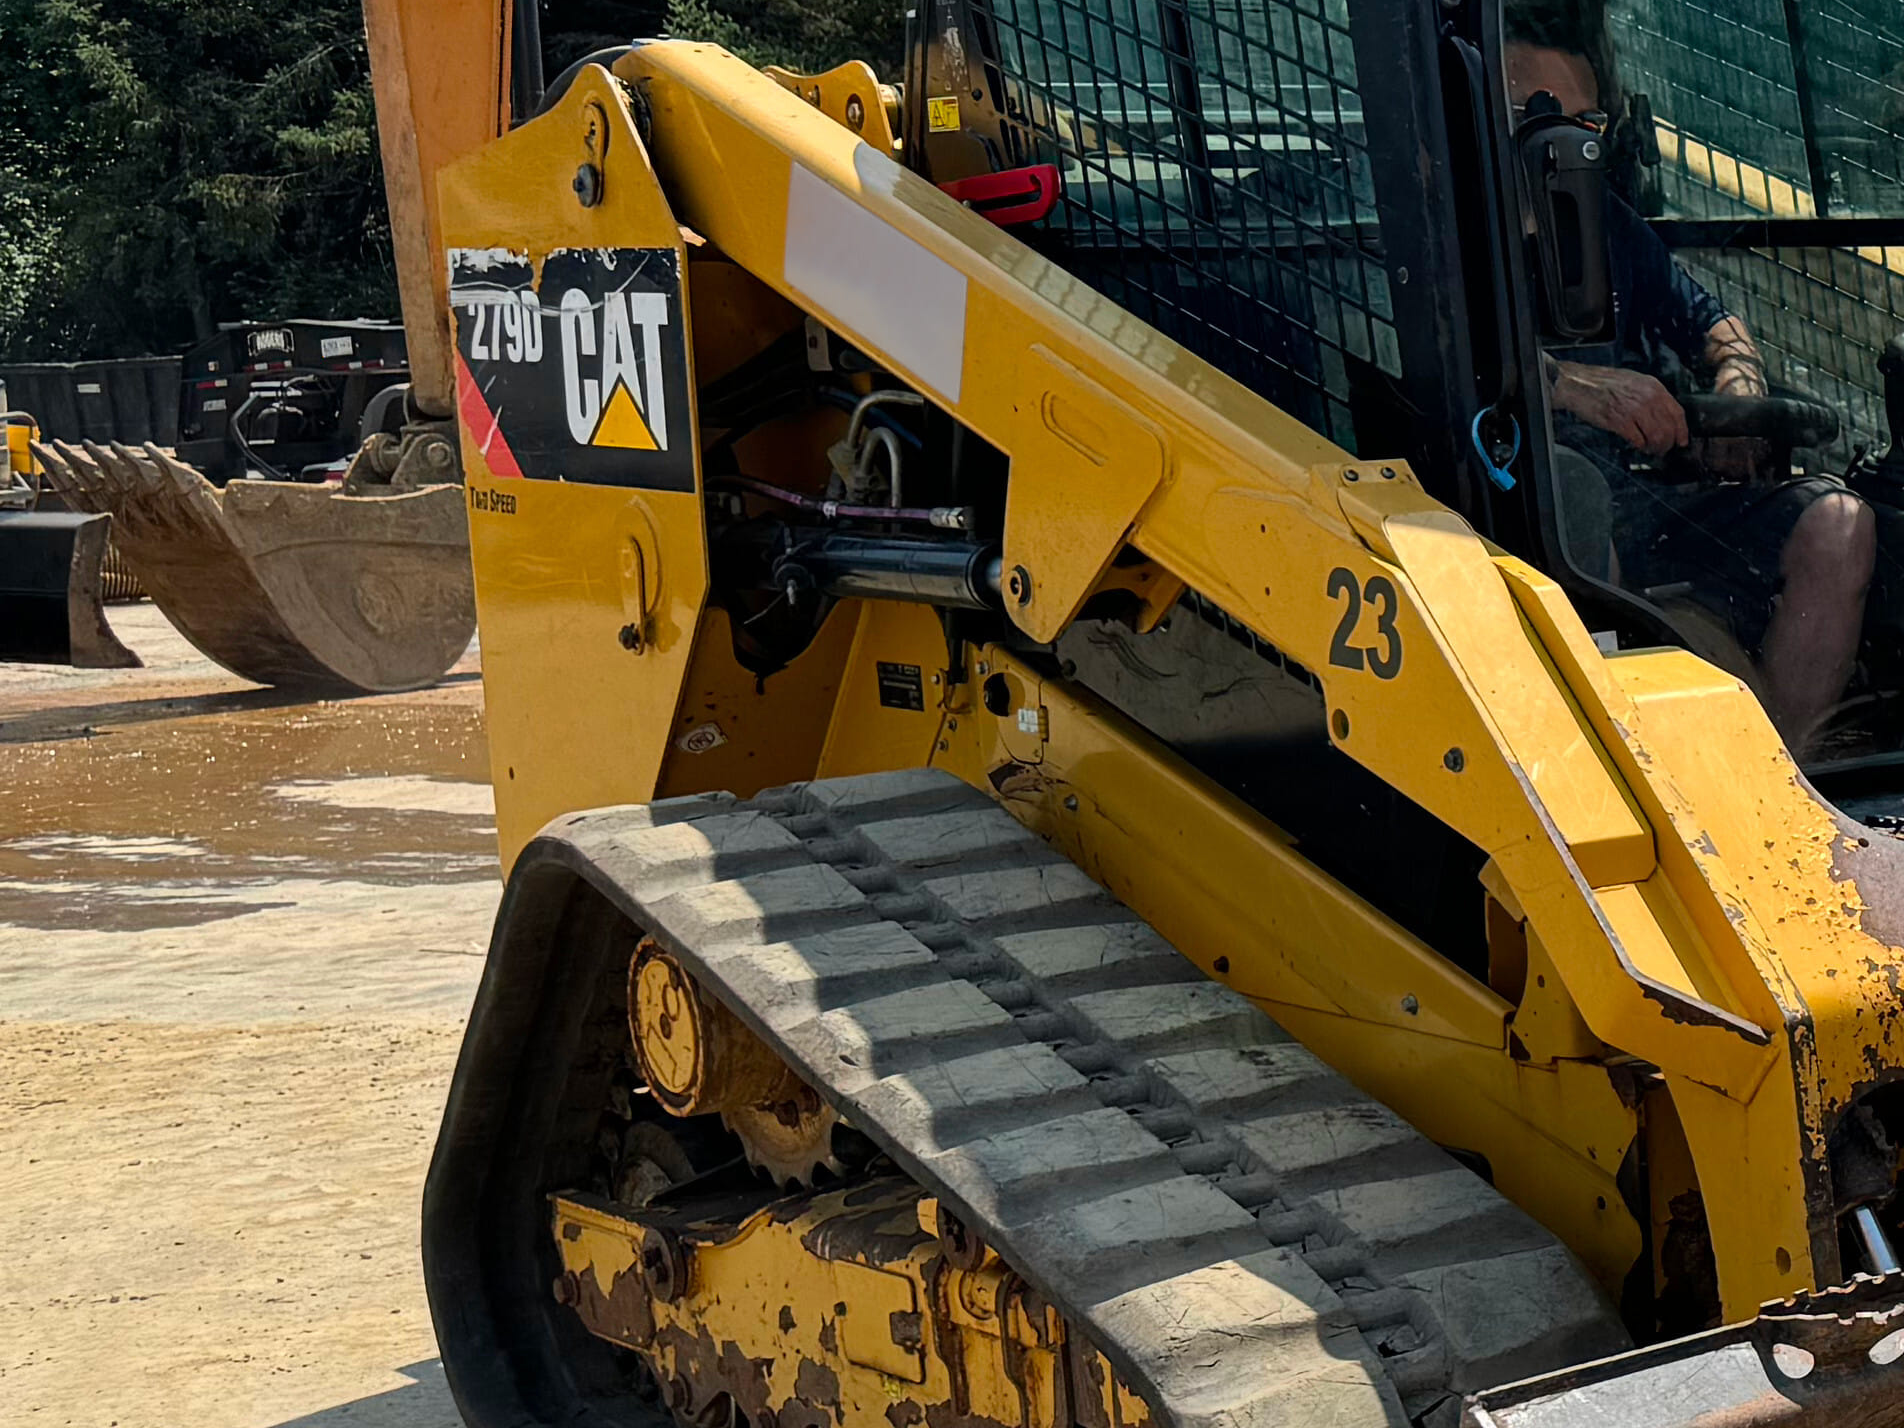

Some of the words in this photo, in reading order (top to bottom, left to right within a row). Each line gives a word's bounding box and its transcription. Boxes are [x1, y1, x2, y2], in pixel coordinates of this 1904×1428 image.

[467, 290, 544, 363] 279D
[560, 287, 668, 451] CAT
[1326, 567, 1402, 680] 23
